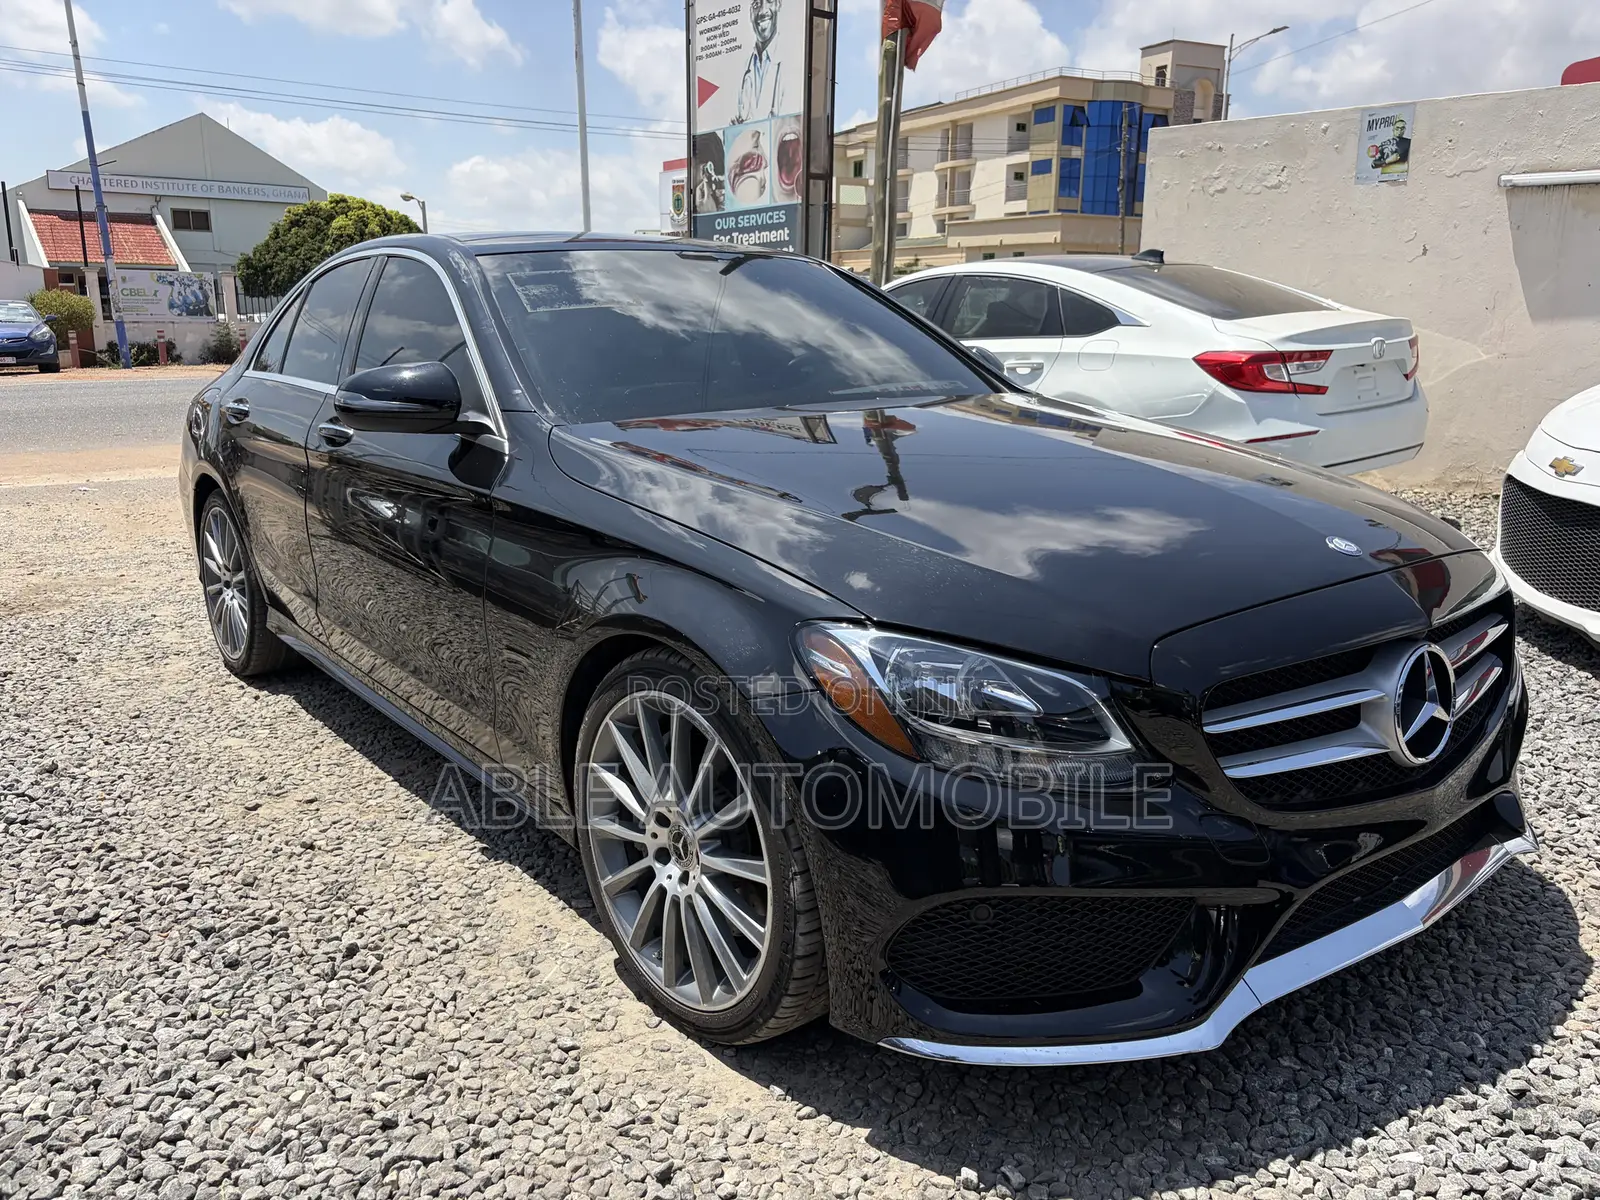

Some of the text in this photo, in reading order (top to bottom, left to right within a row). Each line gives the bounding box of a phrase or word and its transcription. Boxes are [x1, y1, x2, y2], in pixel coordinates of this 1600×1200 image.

[699, 18, 739, 36] WORKING HOURS
[69, 175, 308, 200] CHATERED INSTITUTE OF BANKERS, GHANA
[715, 210, 786, 230] OUR SERVICES
[732, 227, 790, 245] Treatment
